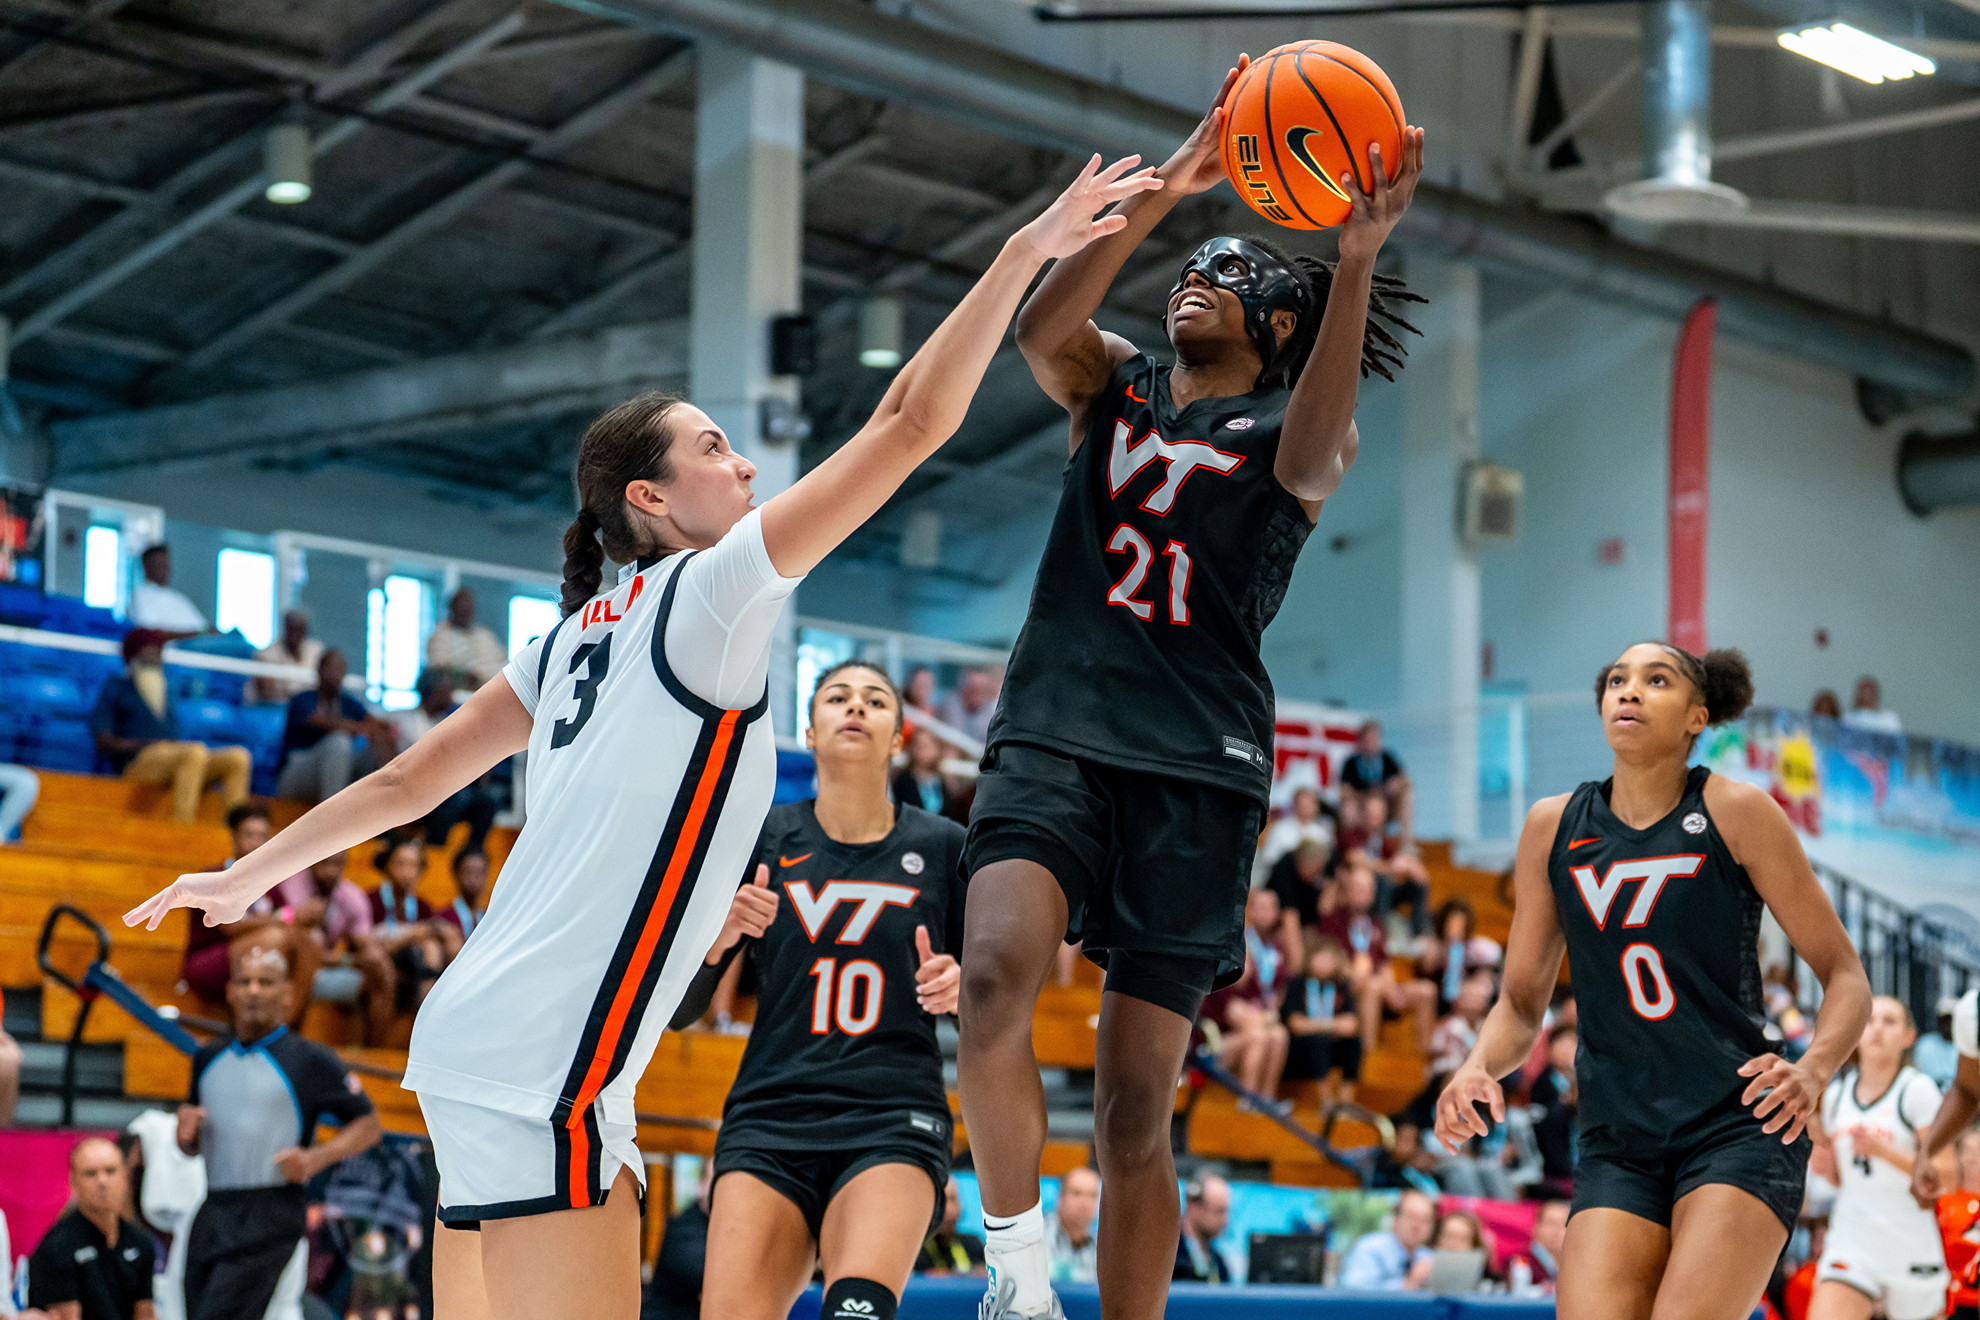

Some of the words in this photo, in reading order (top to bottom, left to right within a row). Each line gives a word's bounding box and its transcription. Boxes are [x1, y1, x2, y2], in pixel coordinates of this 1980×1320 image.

[1237, 134, 1294, 221] ELITE
[1107, 418, 1247, 517] VT
[1106, 523, 1193, 626] 21
[550, 631, 613, 750] 3
[1256, 752, 1263, 765] M
[783, 879, 921, 945] VT
[1569, 853, 1707, 931] VT
[809, 957, 885, 1036] 10
[1620, 942, 1677, 1021] 0
